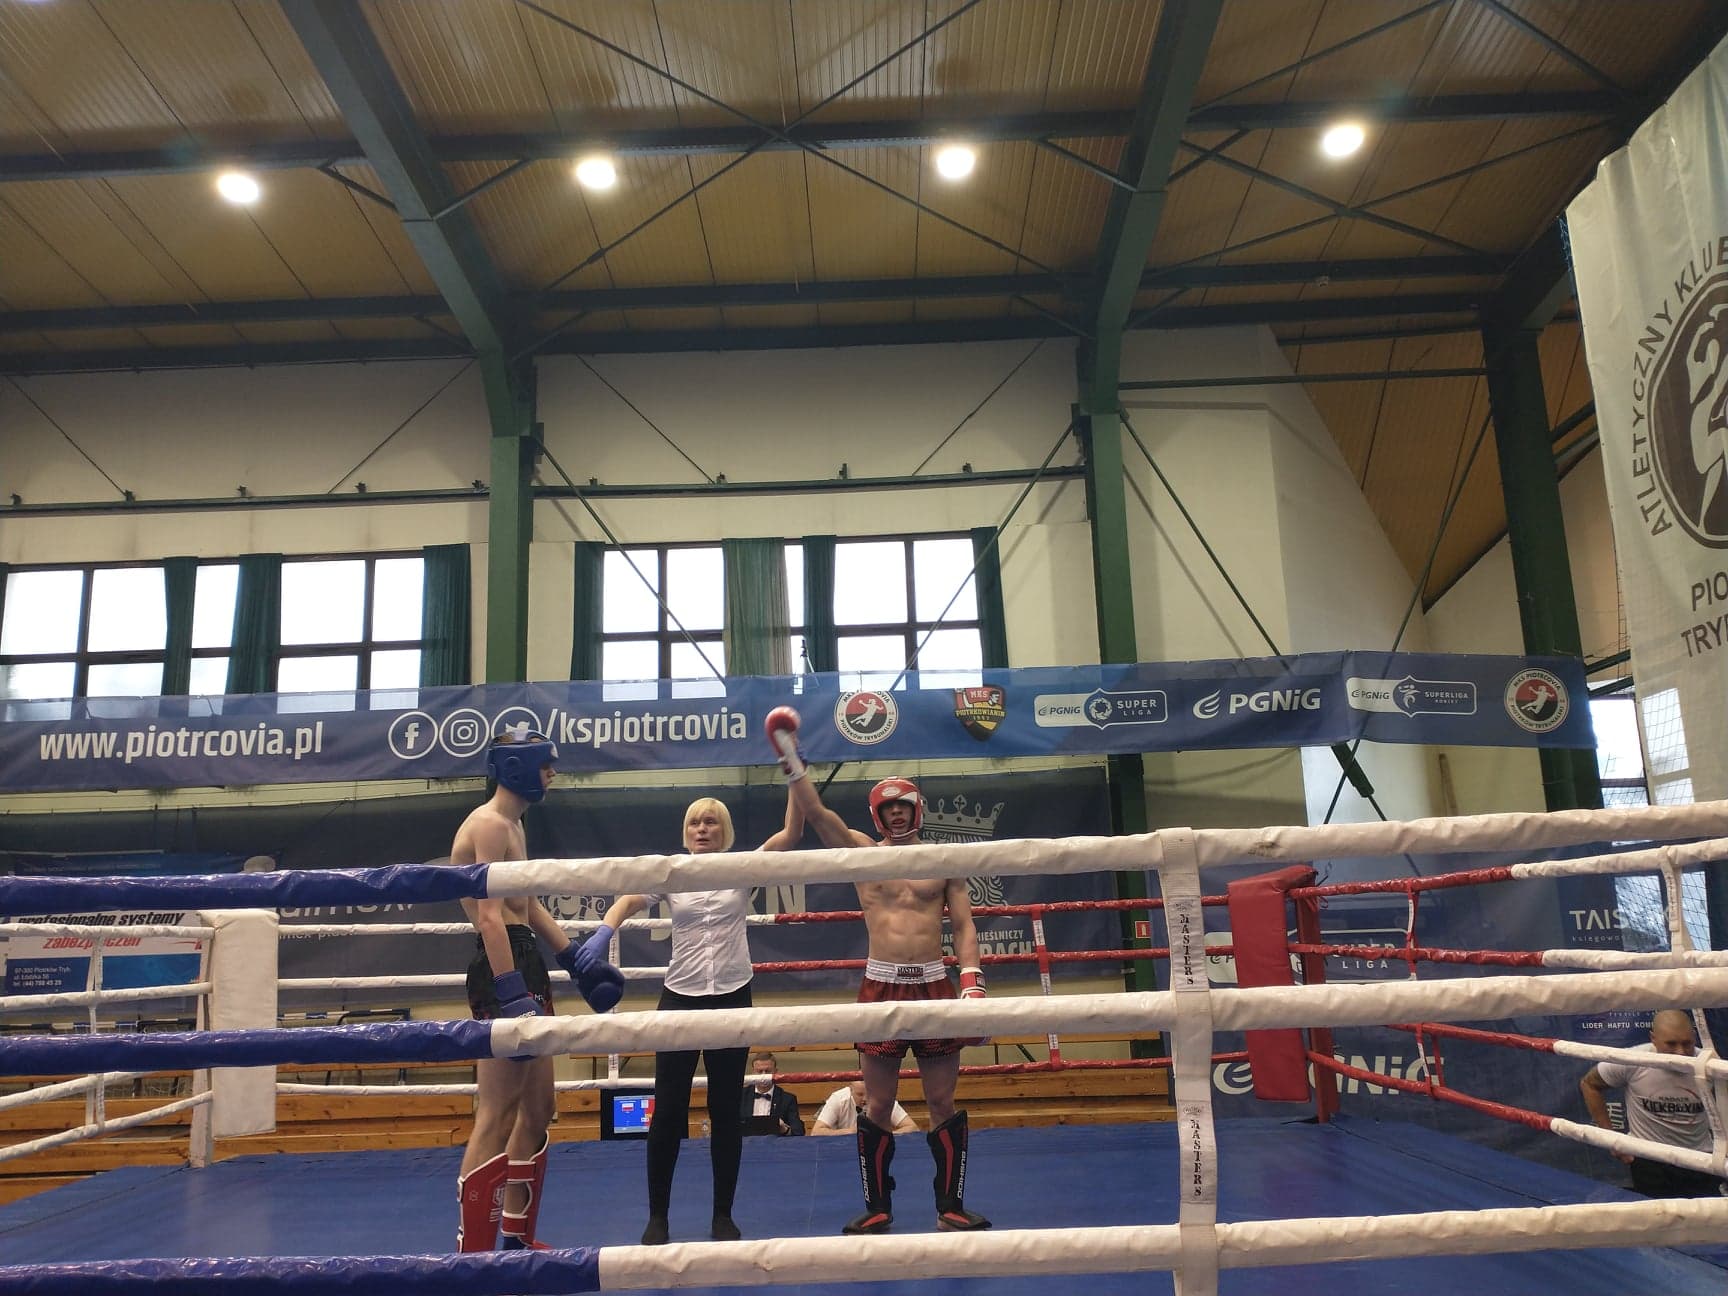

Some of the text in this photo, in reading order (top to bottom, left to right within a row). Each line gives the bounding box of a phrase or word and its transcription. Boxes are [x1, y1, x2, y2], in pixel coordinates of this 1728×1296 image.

[1632, 300, 1673, 536] ATLETYCZNY
[1681, 615, 1728, 657] TRY
[1361, 690, 1390, 700] PGNiG
[1424, 691, 1468, 699] SUPERLIGA
[1117, 699, 1157, 709] SUPER
[1229, 688, 1321, 714] PGNiG
[1049, 706, 1081, 715] PGNiG
[40, 721, 323, 764] www.piotrcovia.pl
[1342, 961, 1389, 969] LIGA
